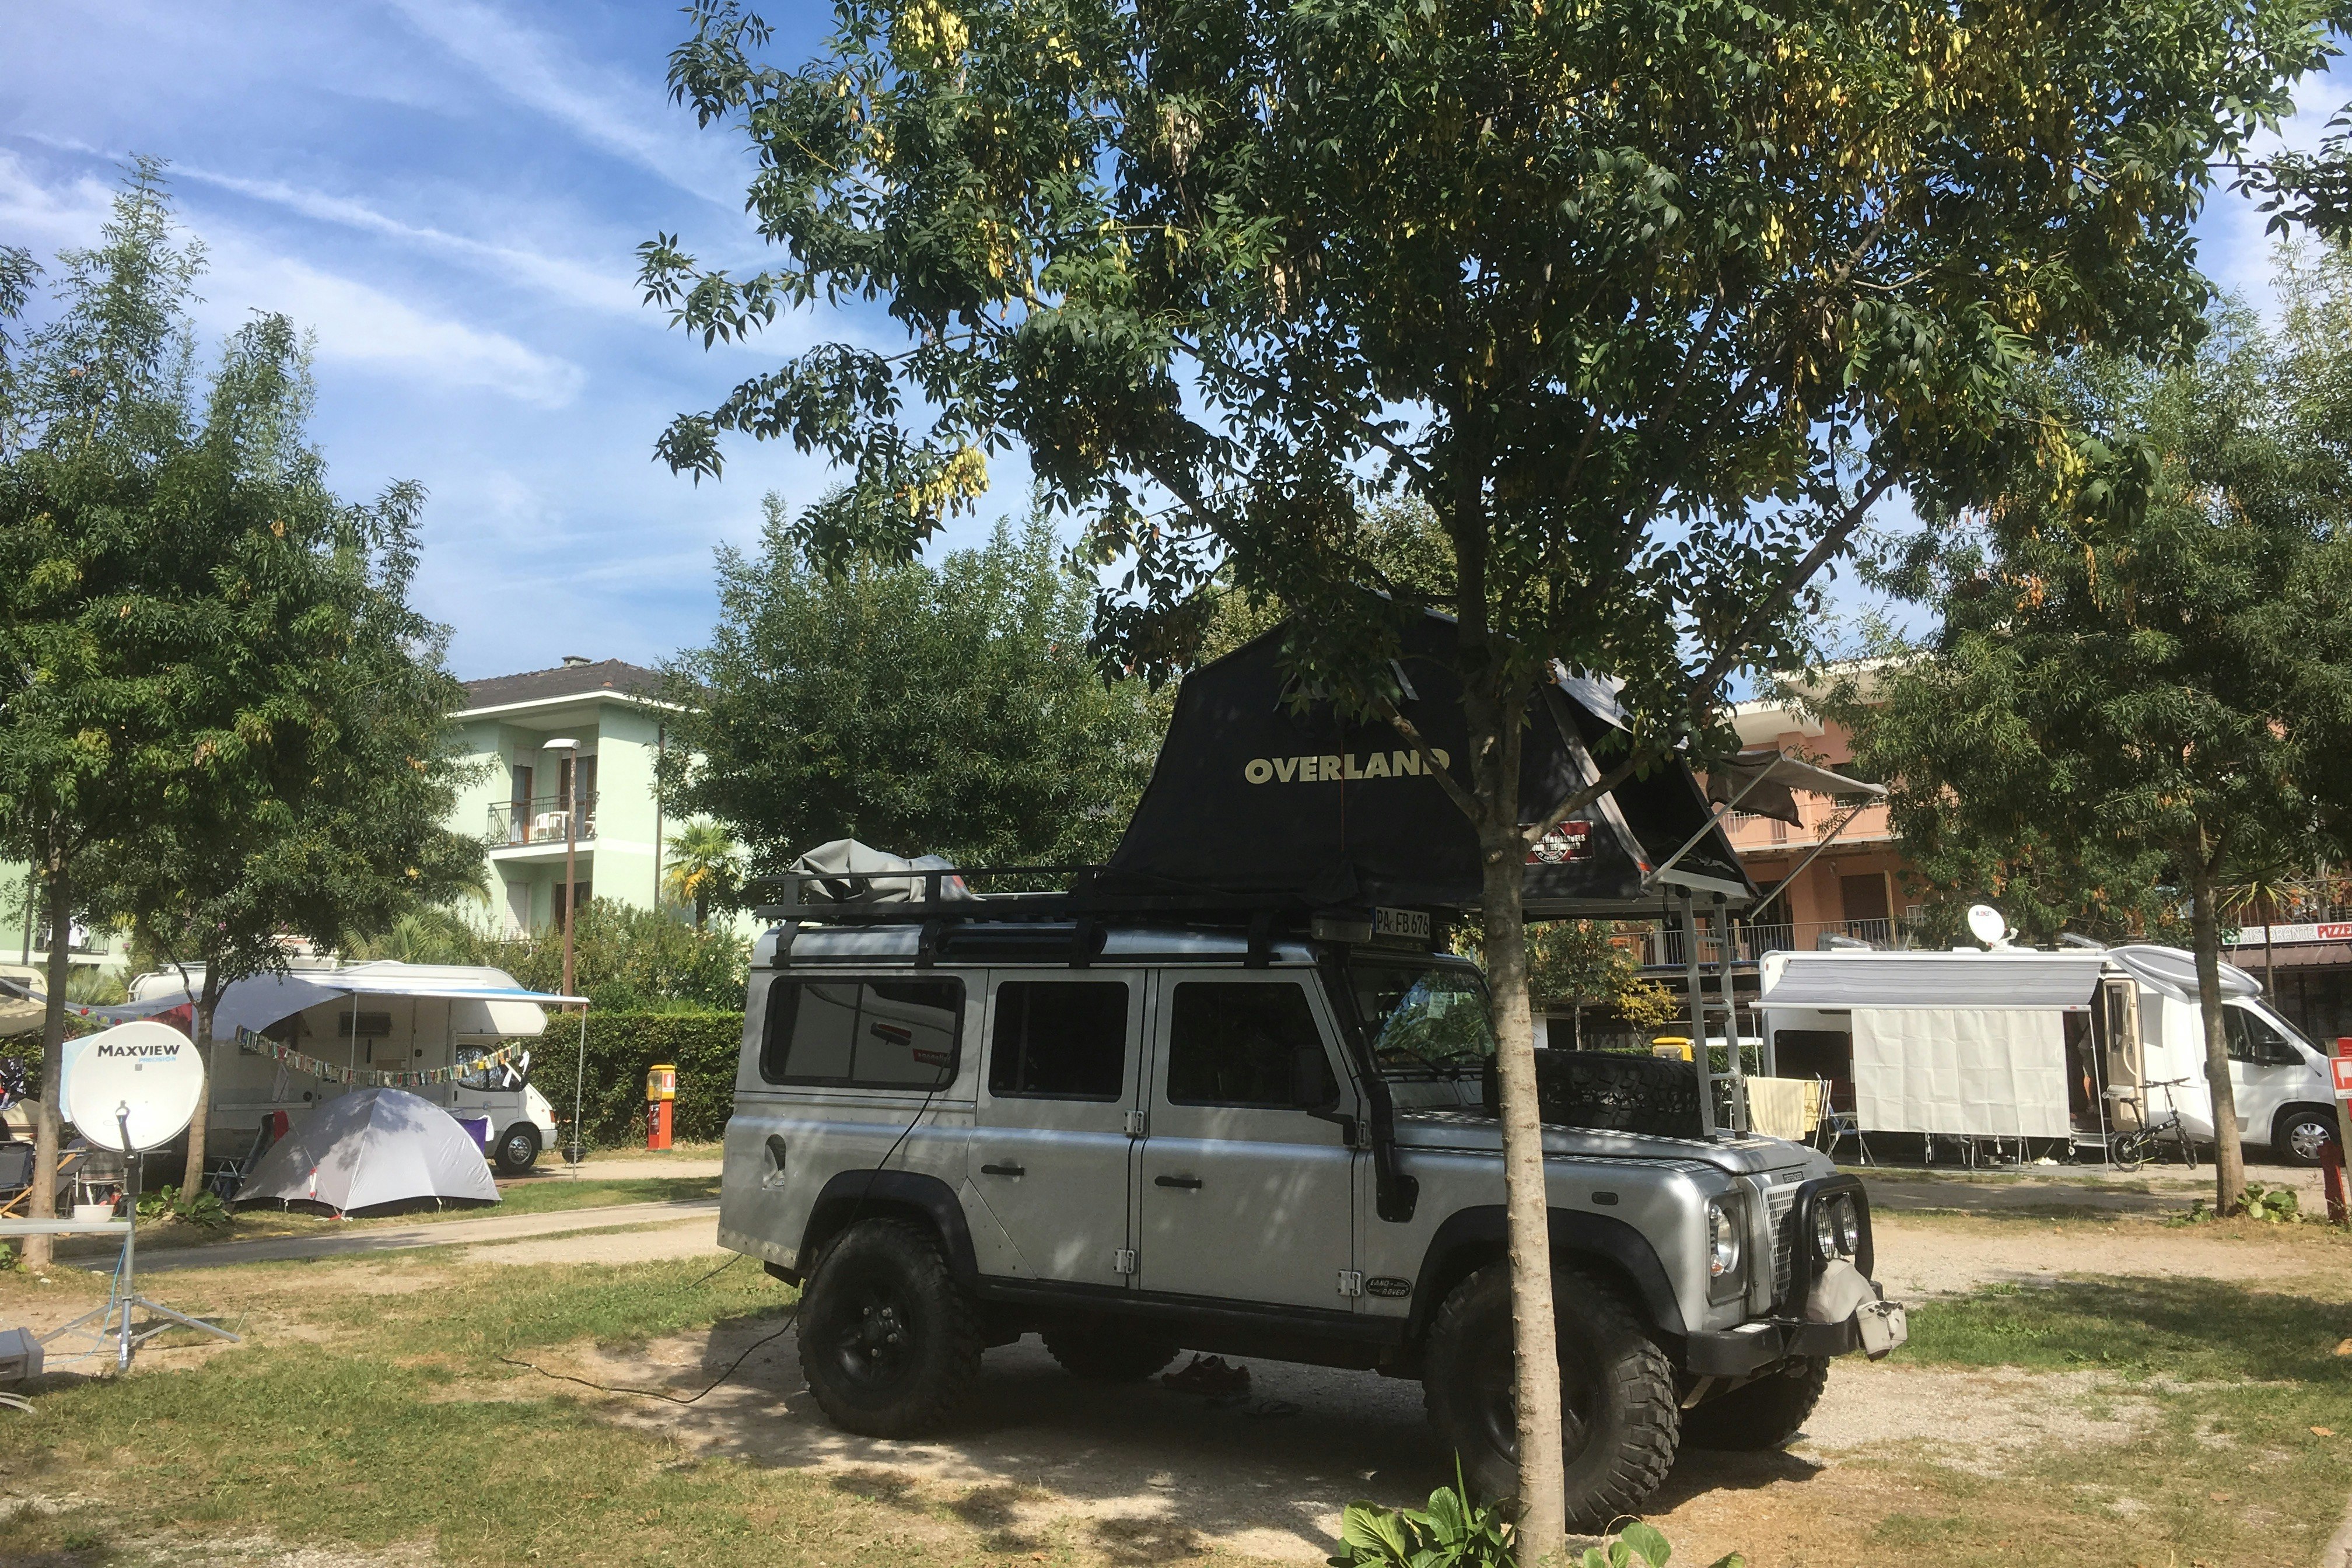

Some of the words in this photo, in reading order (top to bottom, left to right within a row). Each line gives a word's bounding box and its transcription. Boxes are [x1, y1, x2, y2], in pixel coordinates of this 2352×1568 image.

[1245, 748, 1450, 784] OVERLAND
[1377, 909, 1390, 931] PA
[1396, 912, 1409, 933] FB
[1411, 914, 1429, 935] 676
[2241, 926, 2316, 943] RISTORANTE
[2317, 923, 2352, 939] PIZZE
[97, 1045, 180, 1057] MAXVIEW
